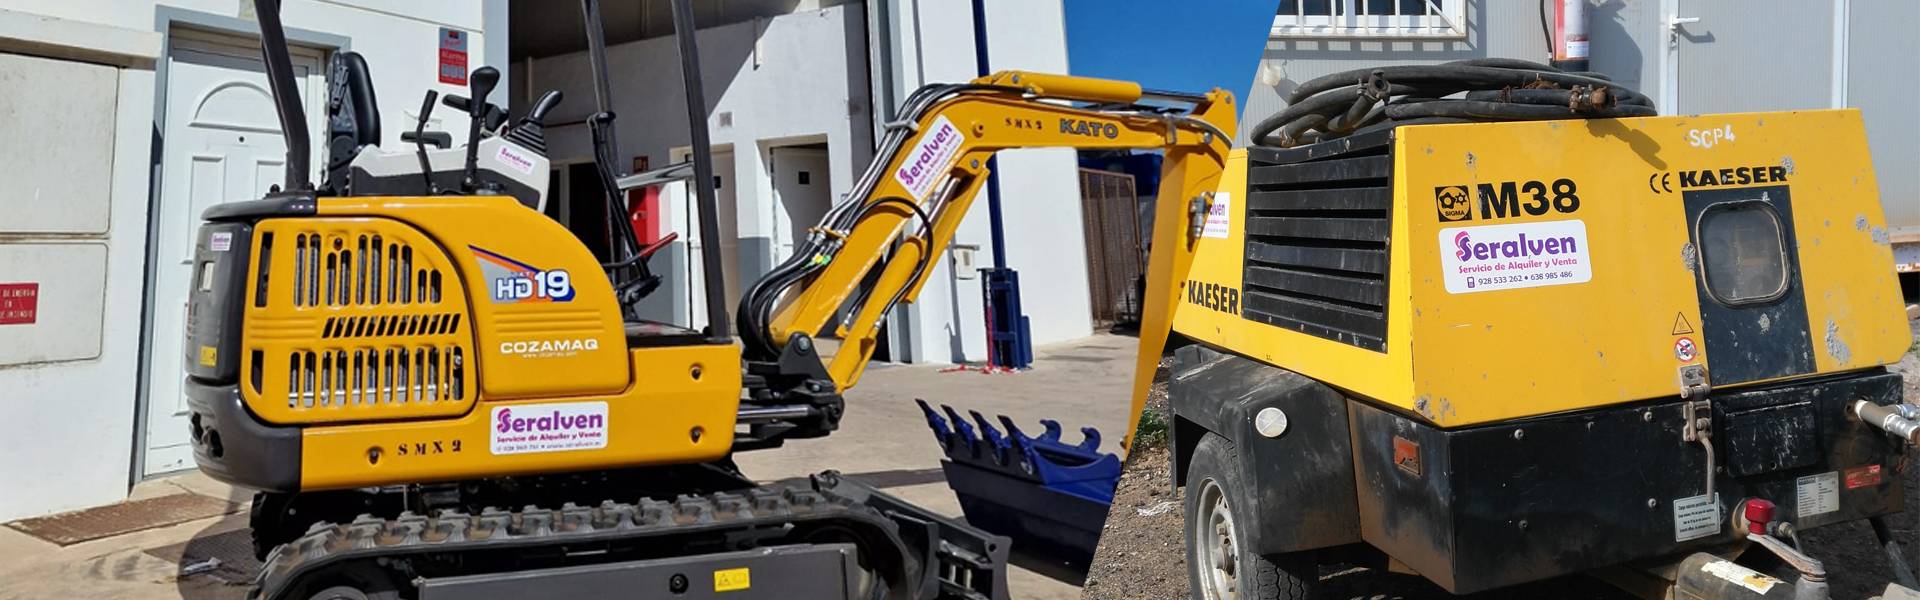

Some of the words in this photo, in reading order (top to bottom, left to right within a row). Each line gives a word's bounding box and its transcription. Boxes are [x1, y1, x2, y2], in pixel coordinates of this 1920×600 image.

[1060, 118, 1118, 139] KATO
[1689, 124, 1736, 148] SCP4
[900, 124, 952, 185] Seralven
[1679, 166, 1788, 188] KAESER
[1477, 178, 1580, 220] M38
[1455, 231, 1577, 262] Seralven
[1458, 265, 1492, 274] Servicio
[1494, 263, 1506, 271] de
[1508, 260, 1542, 270] Alquiler
[1552, 258, 1578, 266] Venta
[496, 270, 570, 299] HD19
[1188, 280, 1238, 315] KAESER
[500, 338, 598, 354] COZAMAQ
[497, 408, 603, 433] Seralven
[540, 433, 570, 441] Alquiler
